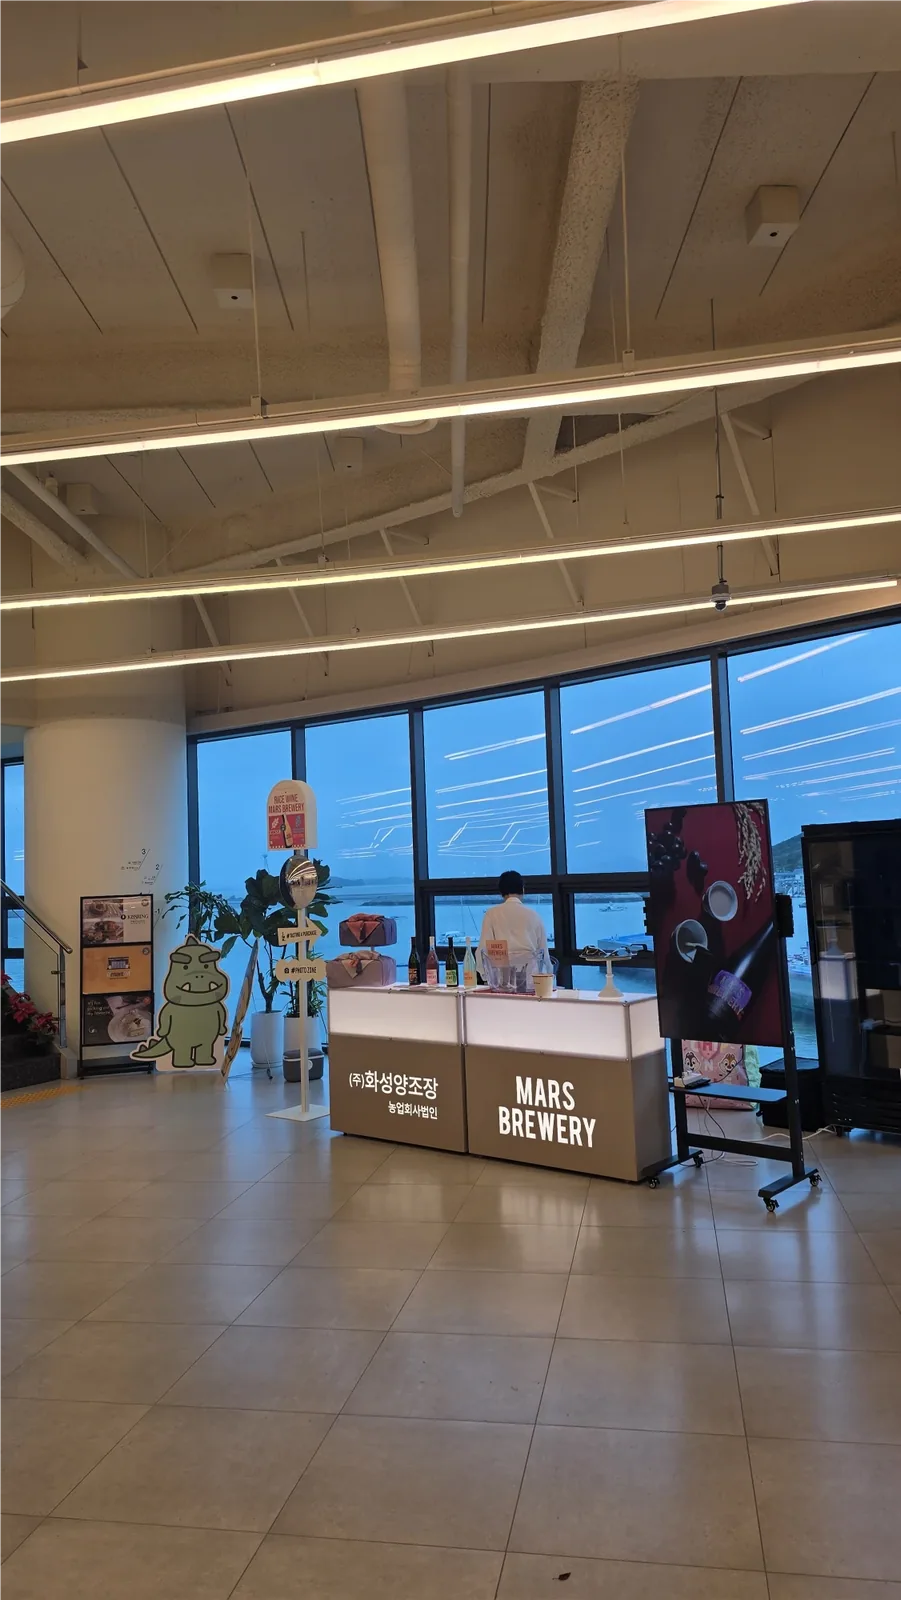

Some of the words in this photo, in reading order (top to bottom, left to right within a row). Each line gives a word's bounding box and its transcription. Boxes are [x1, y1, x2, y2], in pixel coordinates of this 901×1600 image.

[268, 804, 282, 814] MARS
[282, 802, 305, 813] BREWERY
[273, 794, 285, 804] RICE
[285, 793, 299, 803] WINE
[155, 863, 160, 871] 2
[349, 1070, 438, 1100] (주)화성양조장
[515, 1075, 575, 1111] MARS
[388, 1100, 438, 1120] 농업회사법인
[498, 1105, 596, 1148] BREWERY
